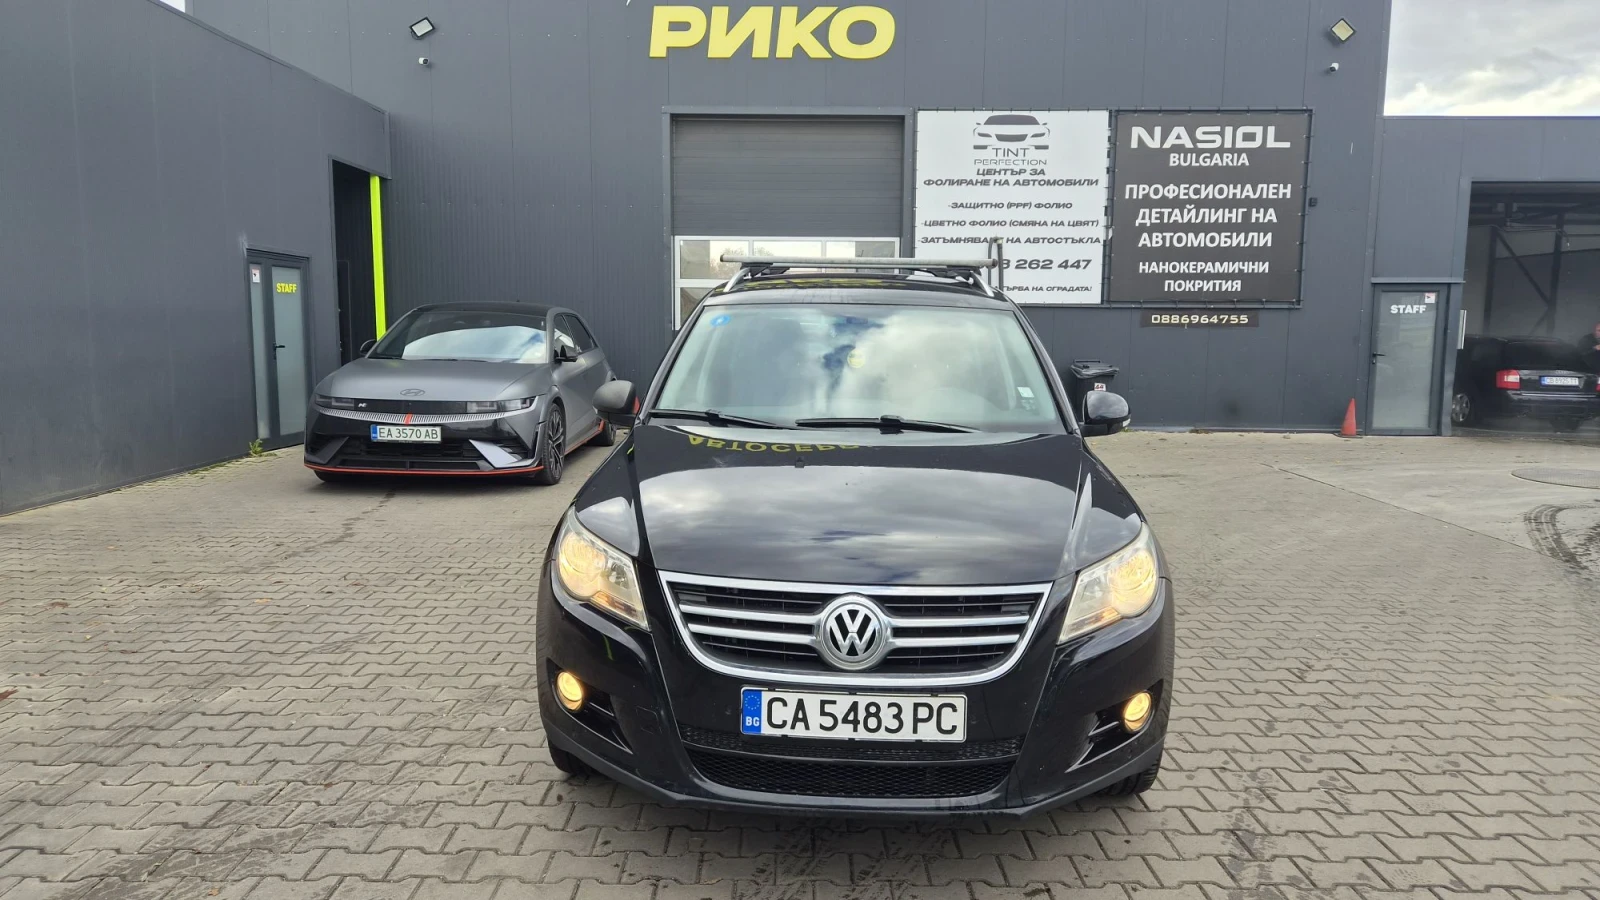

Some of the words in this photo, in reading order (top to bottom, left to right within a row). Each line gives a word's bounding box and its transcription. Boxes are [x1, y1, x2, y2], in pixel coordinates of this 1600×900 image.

[649, 6, 896, 59] РИКО
[1130, 125, 1291, 149] NASIOL
[992, 148, 1030, 158] TINT
[1169, 152, 1250, 167] BULGARIA
[976, 168, 1027, 176] ЦЕНТЪР
[1029, 168, 1046, 176] ЗА
[923, 178, 991, 187] ФОЛИРАНЕ
[1013, 178, 1099, 186] АВТОМОБИЛИ
[1124, 183, 1292, 200] ПРОФЕСИОНАЛЕН
[1006, 202, 1032, 210] (PPF)
[1135, 204, 1248, 227] ДЕТАЙЛИНГ
[1251, 207, 1278, 224] НА
[968, 219, 1007, 227] ФОЛИО
[1009, 219, 1048, 227] (СМЯНА
[1050, 219, 1065, 227] НА
[1067, 219, 1099, 227] ЦВЯТ)
[1005, 236, 1022, 244] НА
[1024, 236, 1101, 244] АВТОСТЪКЛА
[1138, 232, 1273, 248] АВТОМОБИЛИ
[1014, 259, 1054, 270] 262
[1057, 259, 1092, 270] 447
[1138, 261, 1269, 274] НАНОКЕРАМИЧНИ
[276, 282, 297, 293] STAFF
[1164, 279, 1242, 292] ПОКРИТИЯ
[1390, 304, 1427, 314] STAFF
[1151, 314, 1249, 325] 0886964755
[379, 427, 393, 438] EA
[395, 428, 422, 439] 3570
[424, 429, 439, 439] AB
[745, 716, 760, 727] BG
[766, 697, 811, 731] CA
[819, 699, 904, 734] 5483
[912, 702, 958, 735] PC
